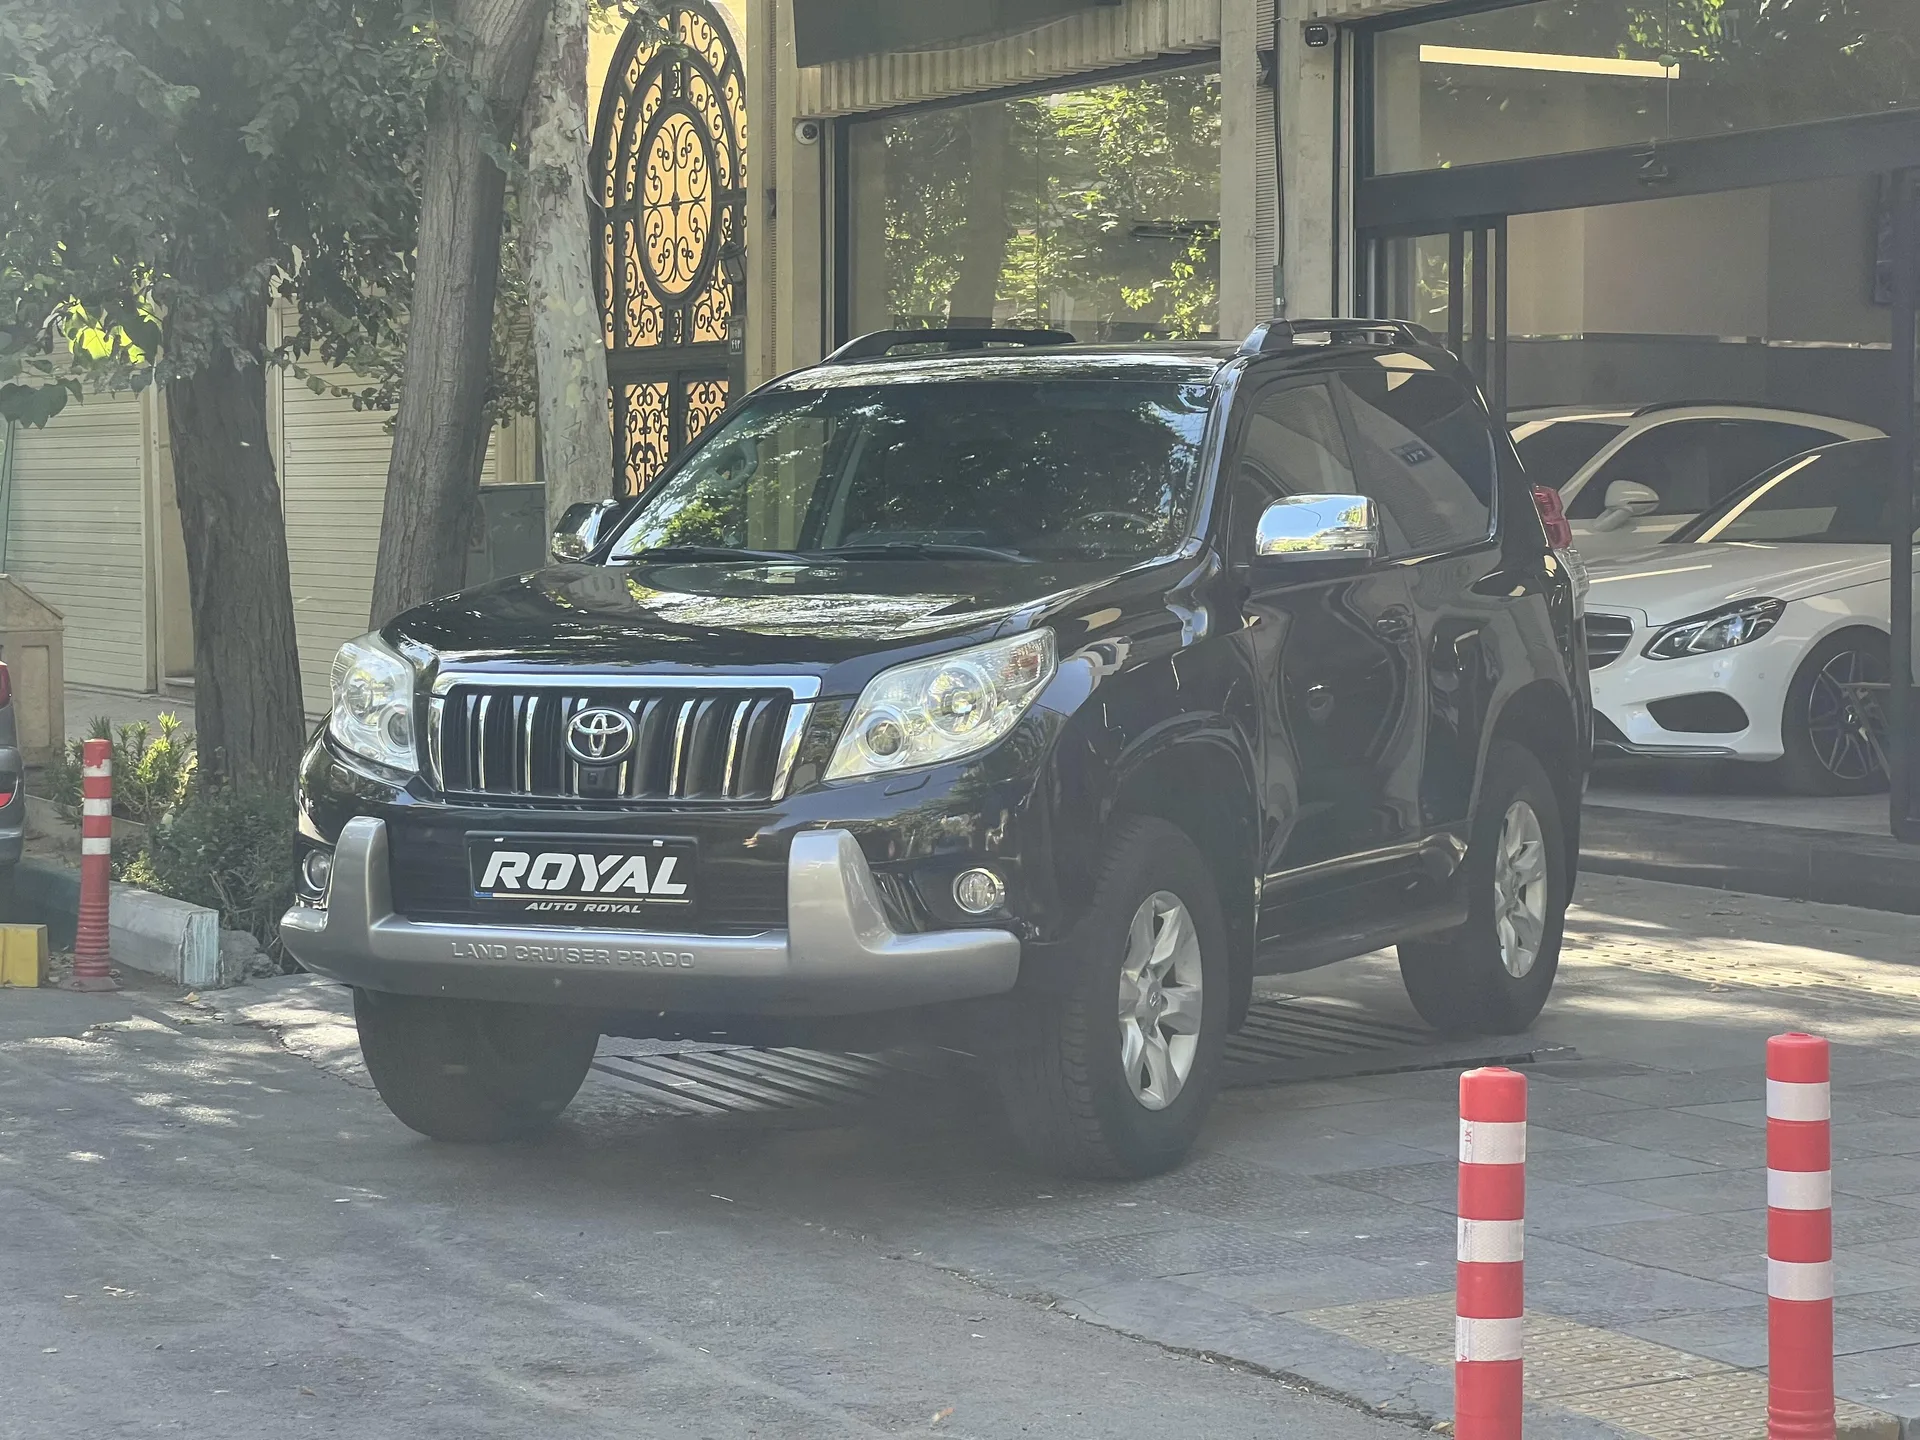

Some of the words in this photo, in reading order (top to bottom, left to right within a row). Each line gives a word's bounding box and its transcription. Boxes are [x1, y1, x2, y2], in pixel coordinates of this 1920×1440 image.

[480, 851, 688, 895] ROYAL
[525, 902, 577, 911] AUTO
[583, 903, 641, 914] ROYAL
[451, 942, 508, 960] LAND
[515, 945, 611, 964] CRUISER
[617, 949, 696, 968] PRADO
